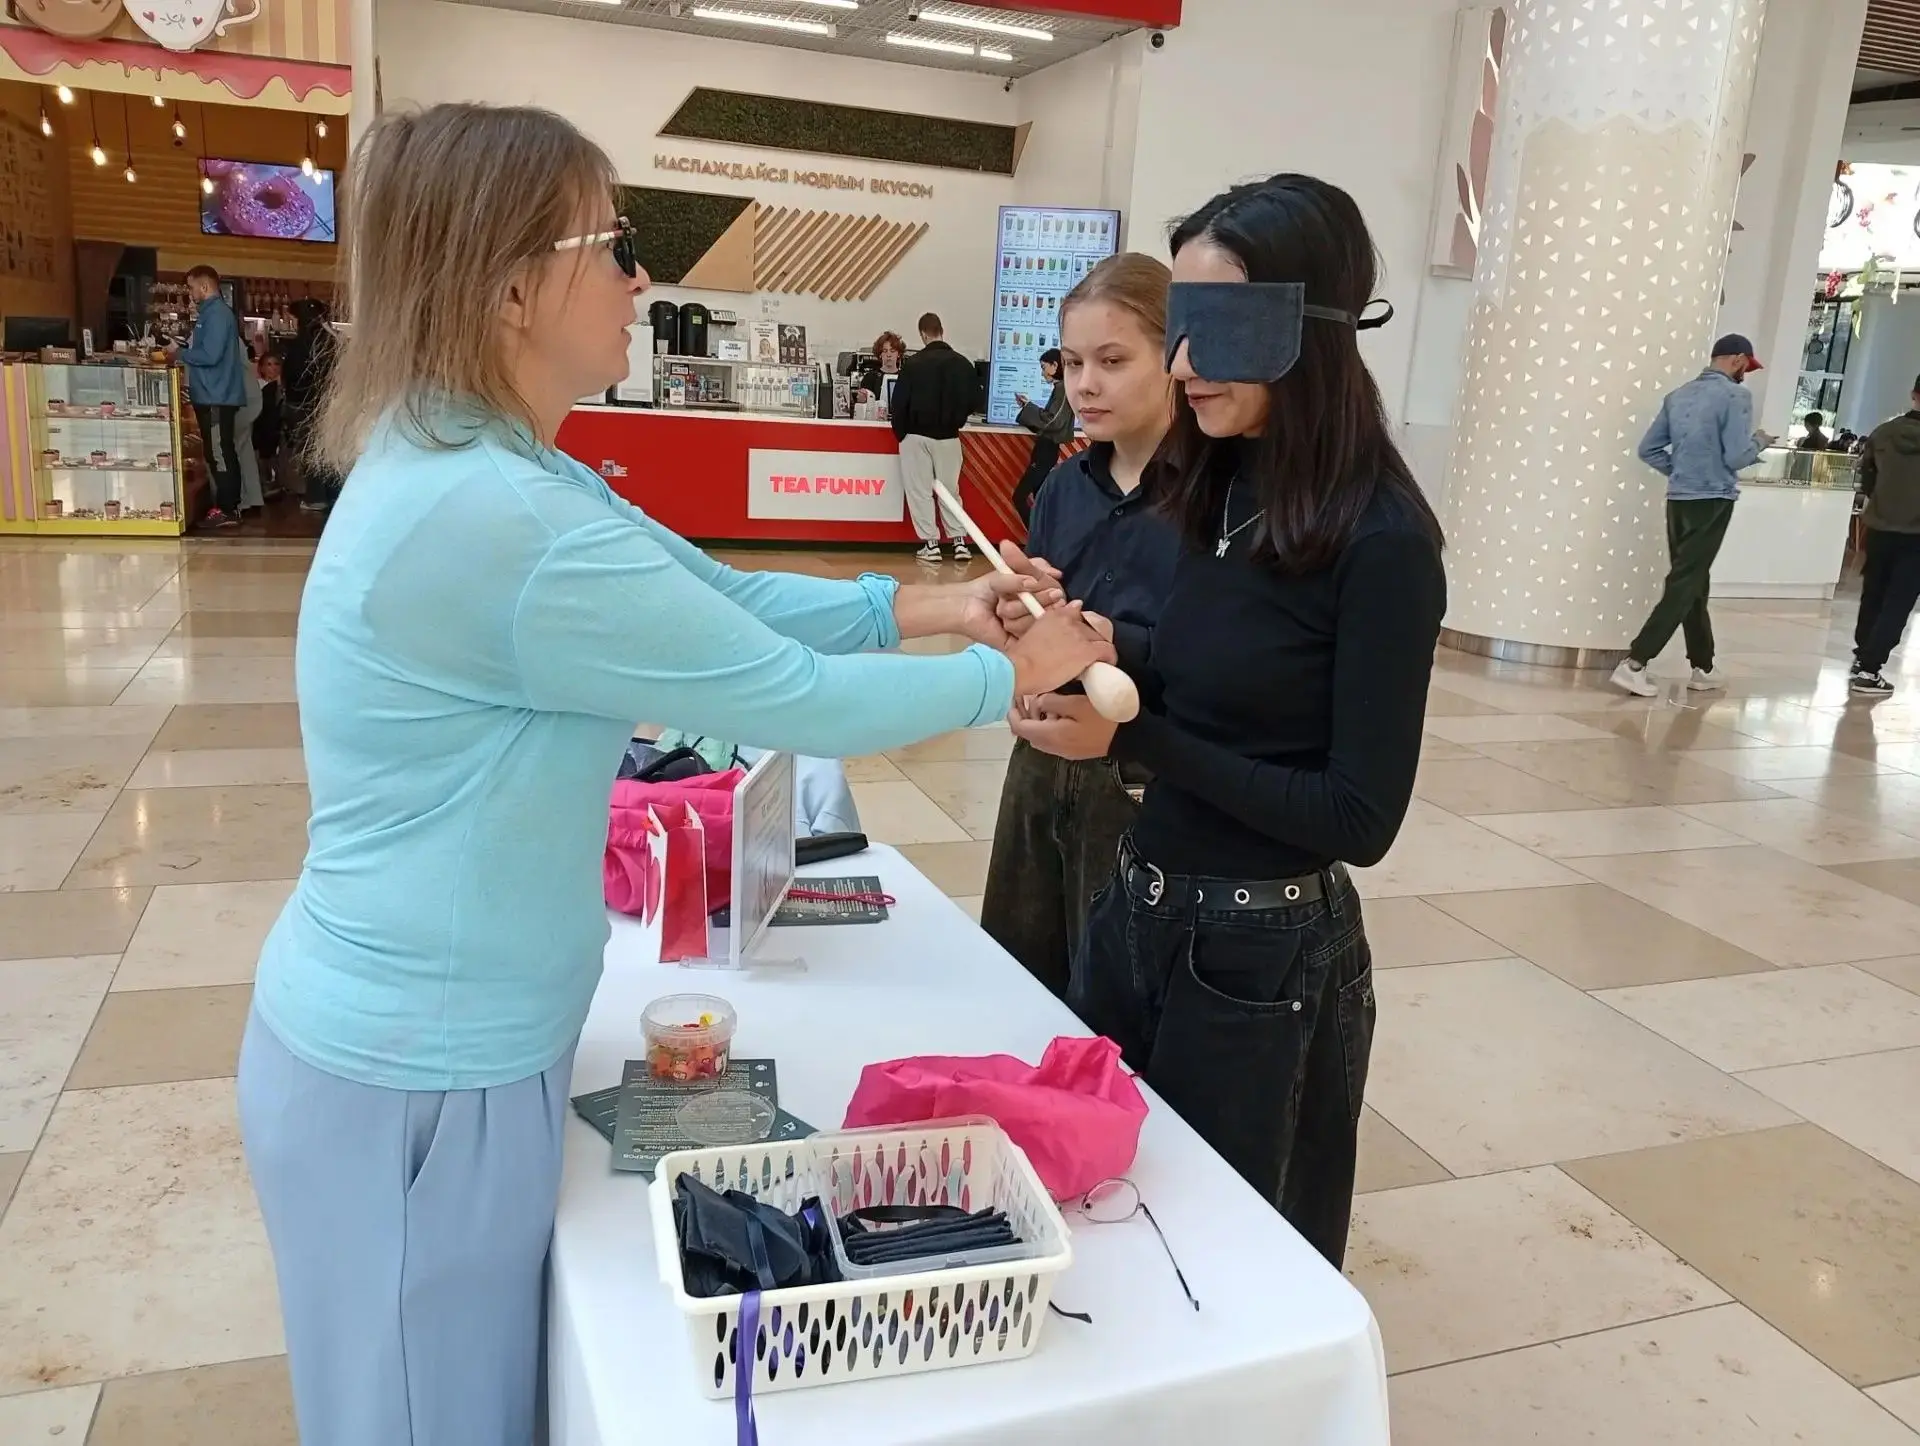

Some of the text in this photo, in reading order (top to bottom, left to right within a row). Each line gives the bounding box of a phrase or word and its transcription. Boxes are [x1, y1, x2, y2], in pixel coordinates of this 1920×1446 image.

[654, 153, 934, 199] НАСЛАЖДАЙСЯ МОДНЫМ ВКУСОМ
[770, 476, 886, 496] TEA FUNNY
